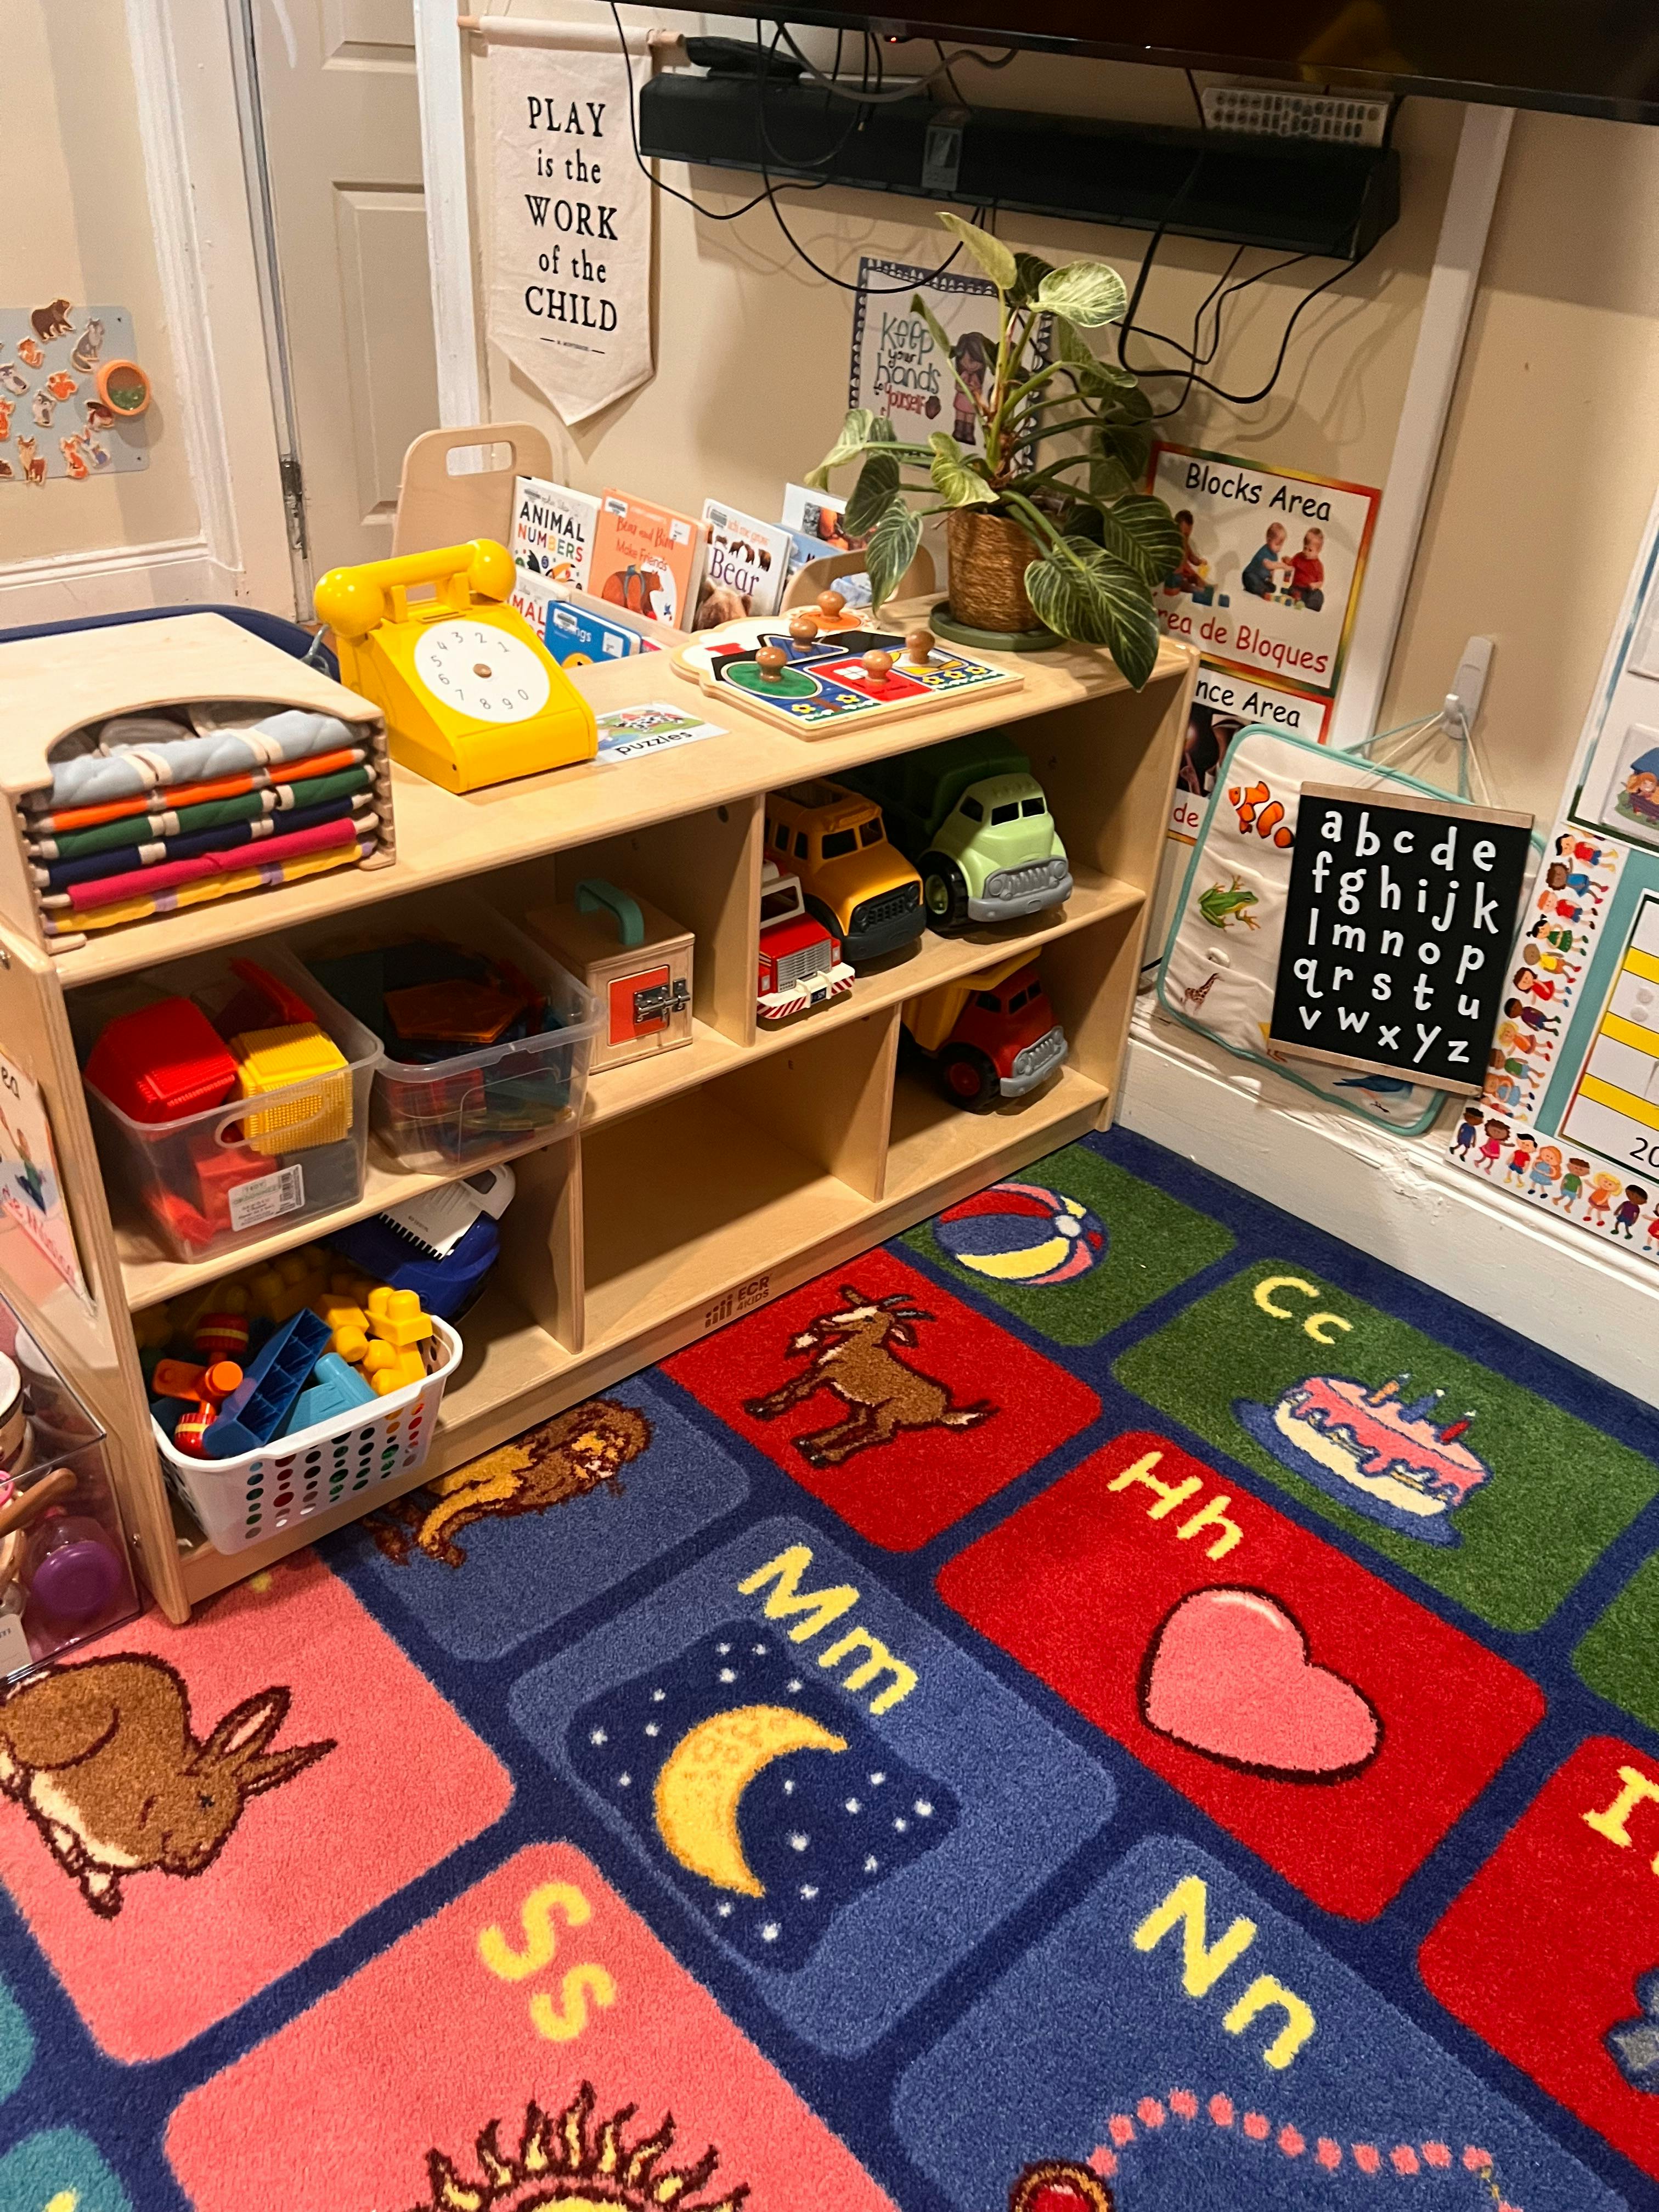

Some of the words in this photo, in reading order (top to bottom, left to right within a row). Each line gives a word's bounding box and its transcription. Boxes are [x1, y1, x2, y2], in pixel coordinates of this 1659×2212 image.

[527, 96, 607, 137] PLAY
[537, 149, 553, 178] is
[566, 150, 601, 184] the
[524, 194, 619, 241] WORK
[538, 245, 561, 274] of
[572, 249, 607, 284] the
[524, 286, 618, 331] CHILD
[874, 353, 941, 394] hands
[888, 349, 917, 368] your
[1186, 462, 1263, 504] Blocks
[1268, 485, 1331, 522] Area
[520, 501, 585, 542] ANIMAL
[518, 523, 583, 562] NUMBERS
[616, 538, 637, 558] Make
[639, 548, 667, 571] Friends
[709, 546, 759, 597] Bear
[436, 641, 448, 651] 4
[451, 631, 464, 644] 3
[475, 632, 488, 644] 2
[498, 641, 510, 653] 1
[1154, 599, 1192, 635] rea
[1200, 616, 1228, 645] de
[1235, 625, 1330, 674] Bloques
[430, 655, 442, 668] 5
[438, 673, 450, 685] 6
[455, 689, 466, 701] 7
[479, 698, 492, 710] 8
[502, 698, 514, 710] 9
[1242, 692, 1301, 728] Area
[614, 729, 693, 757] puzzles
[1321, 810, 1342, 843] a
[1355, 812, 1380, 857] b
[1393, 830, 1414, 854] c
[1431, 826, 1458, 871] d
[1472, 840, 1497, 871] e
[1312, 851, 1333, 894] f
[1338, 868, 1367, 915] g
[1380, 865, 1401, 910] h
[1417, 879, 1428, 913] i
[1432, 880, 1459, 932] j
[1473, 882, 1499, 934] k
[1332, 924, 1365, 952] m
[1380, 929, 1404, 957] n
[1418, 942, 1441, 964] o
[1455, 945, 1485, 984] p
[1294, 958, 1323, 998] q
[1333, 966, 1354, 991] r
[1372, 973, 1391, 1000] s
[1413, 973, 1434, 1011] t
[1458, 995, 1479, 1020] u
[1299, 1006, 1321, 1030] v
[1338, 1007, 1370, 1033] w
[1378, 1025, 1402, 1050] x
[1413, 1023, 1441, 1063] y
[1447, 1041, 1470, 1063] z
[736, 1289, 770, 1311] 4KIDS
[737, 1276, 770, 1302] ECR
[1252, 1277, 1353, 1345] Cc
[1107, 1450, 1244, 1562] Hh
[738, 1541, 917, 1717] Mm
[1578, 1765, 1659, 1875] I
[477, 1881, 617, 2042] Ss
[1133, 1874, 1317, 2070] Nn
